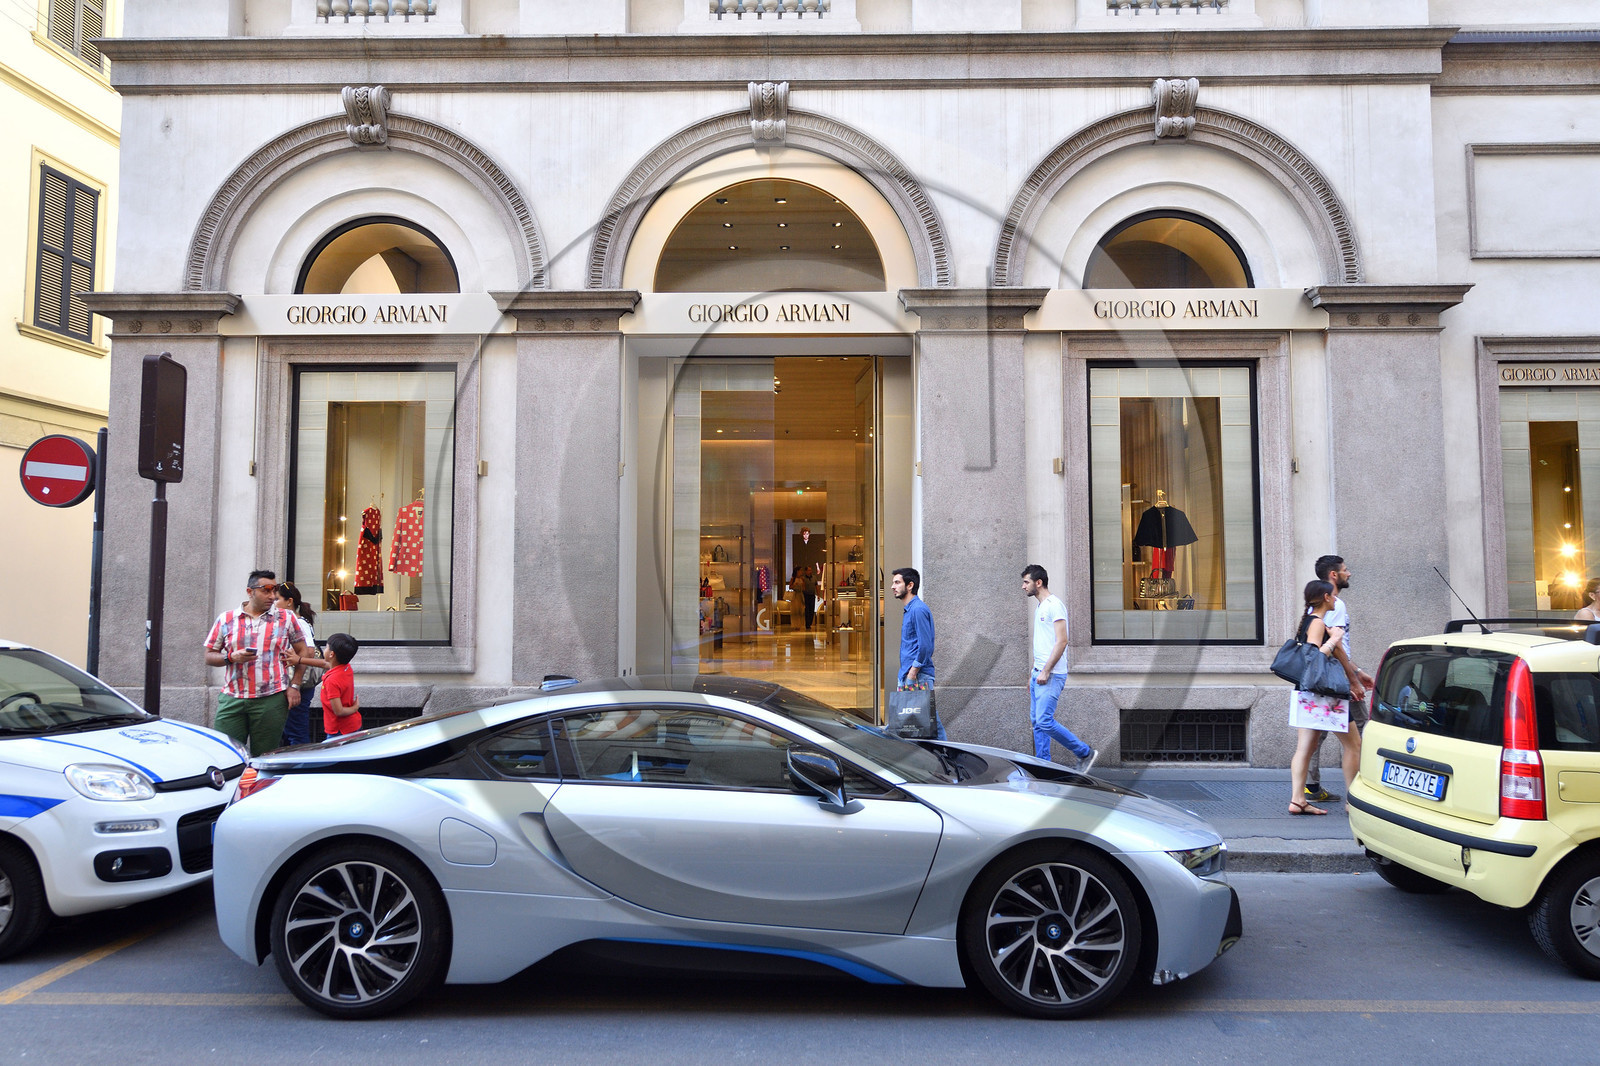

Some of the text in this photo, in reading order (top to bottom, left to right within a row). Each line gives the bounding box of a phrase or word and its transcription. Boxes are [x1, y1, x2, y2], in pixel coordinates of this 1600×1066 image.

[286, 304, 448, 325] GIORGIO ARMANI
[688, 303, 850, 323] GIORGIO ARMANI
[1093, 299, 1259, 319] GIORGIO ARMANI
[1502, 367, 1600, 382] GIORGIO ARMA
[1388, 765, 1436, 793] CR 764YE
